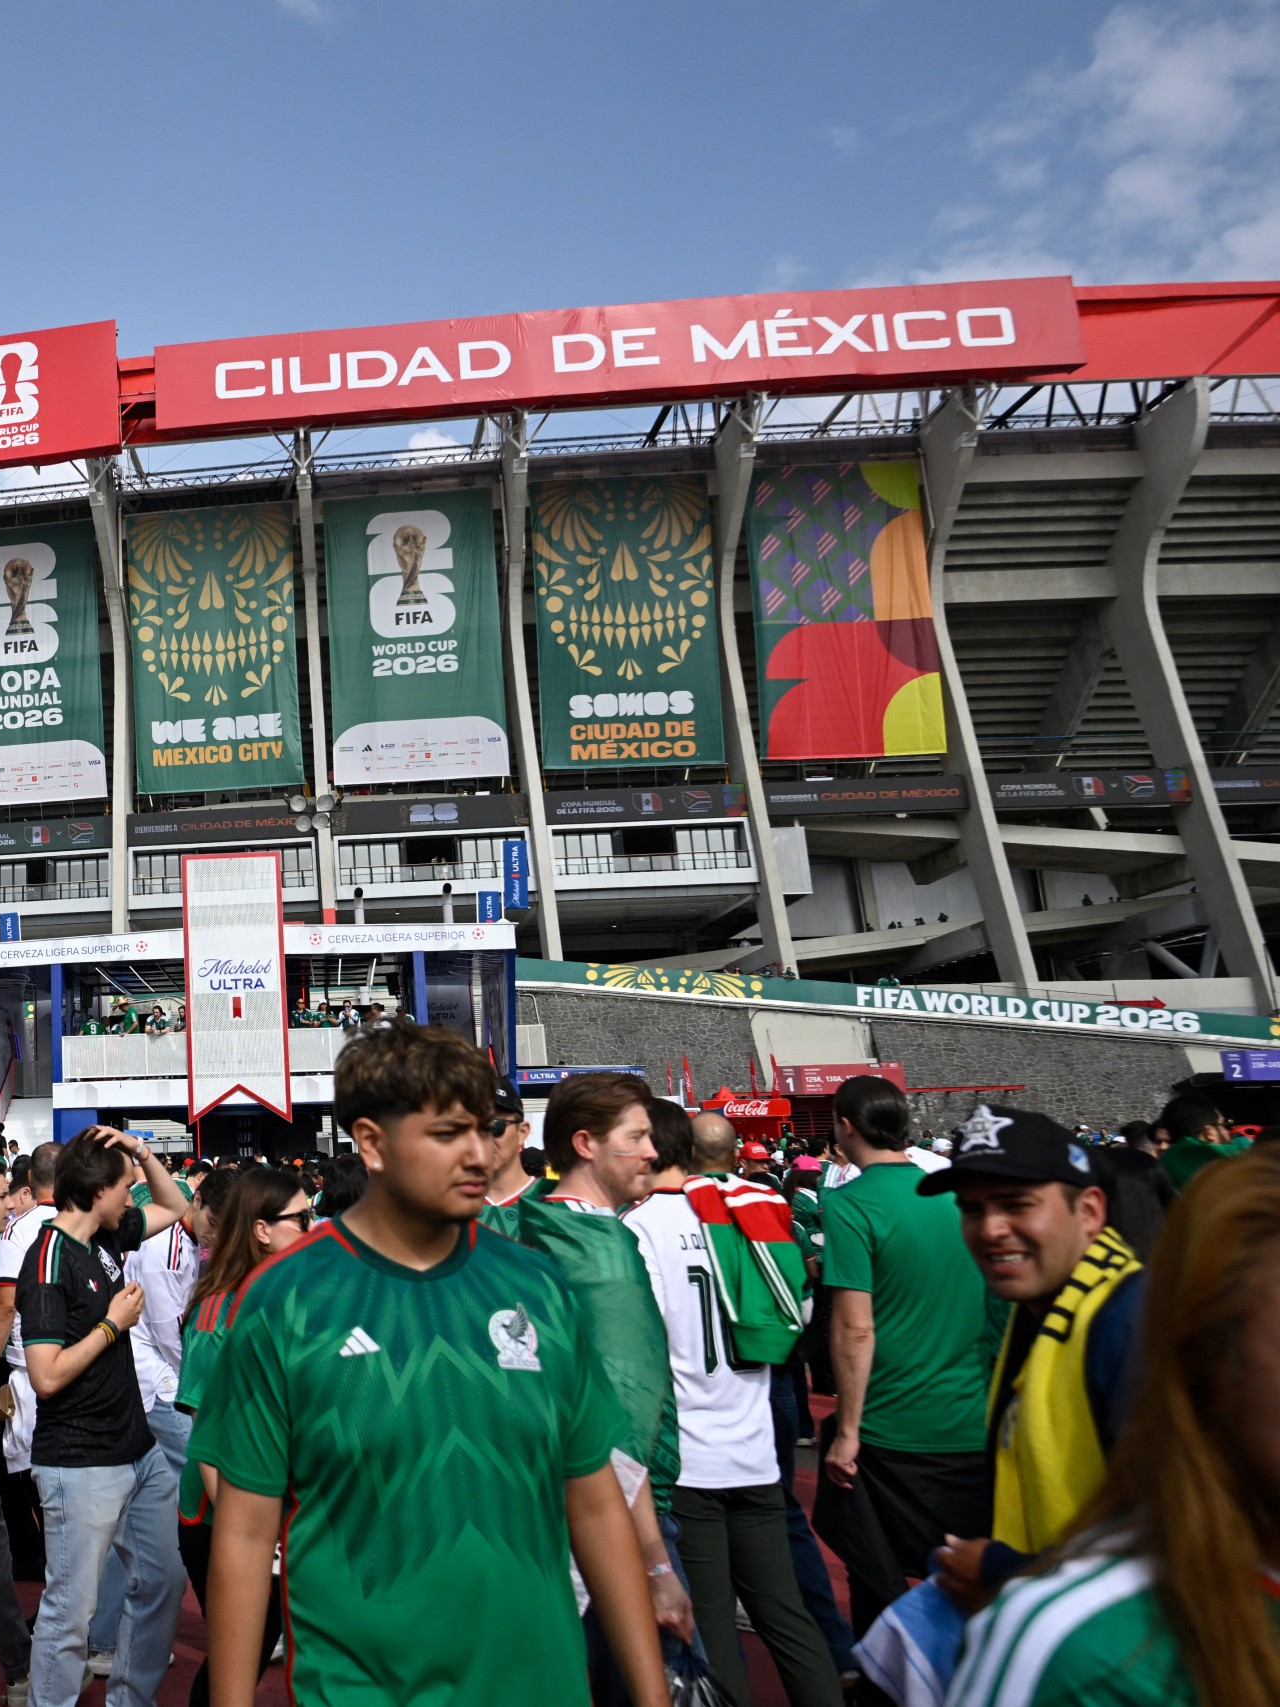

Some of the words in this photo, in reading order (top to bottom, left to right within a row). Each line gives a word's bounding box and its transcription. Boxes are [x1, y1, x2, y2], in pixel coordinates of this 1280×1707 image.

[215, 340, 511, 399] CIUDAD
[553, 327, 661, 373] DE
[690, 306, 1015, 363] MÉXICO
[0, 406, 24, 418] FIFA
[19, 423, 39, 433] CUP
[394, 610, 433, 626] FIFA
[3, 639, 39, 655] FIFA
[371, 641, 426, 656] WORLD
[427, 639, 458, 652] CUP
[372, 654, 459, 677] 2026
[569, 690, 694, 718] SOMOS
[570, 721, 660, 741] CIUDAD
[665, 720, 696, 737] DE
[152, 744, 233, 767] MEXICO
[238, 741, 283, 762] CITY
[571, 739, 696, 761] MÉXICO
[821, 791, 877, 801] CIUDAD
[880, 790, 898, 798] DE
[902, 787, 960, 798] MÉXICO
[578, 806, 595, 814] FIFA
[180, 820, 232, 831] CIUDAD
[235, 819, 252, 828] DE
[255, 816, 297, 827] MÉXIC
[327, 933, 375, 945] CERVEZA
[376, 932, 411, 944] LIGERA
[413, 930, 465, 942] SUPERIOR
[0, 949, 44, 960] CERVEZA
[46, 947, 80, 958] LIGERA
[81, 943, 130, 955] SUPERIOR
[198, 957, 272, 978] Michelob
[209, 978, 265, 991] ULTRA
[856, 986, 918, 1010] FIFA
[921, 990, 1027, 1018] WORLD
[1032, 999, 1090, 1023] CUP
[1095, 1005, 1201, 1034] 2026
[530, 1072, 556, 1080] ULTRA
[1230, 1063, 1243, 1078] 2
[786, 1077, 795, 1092] 1
